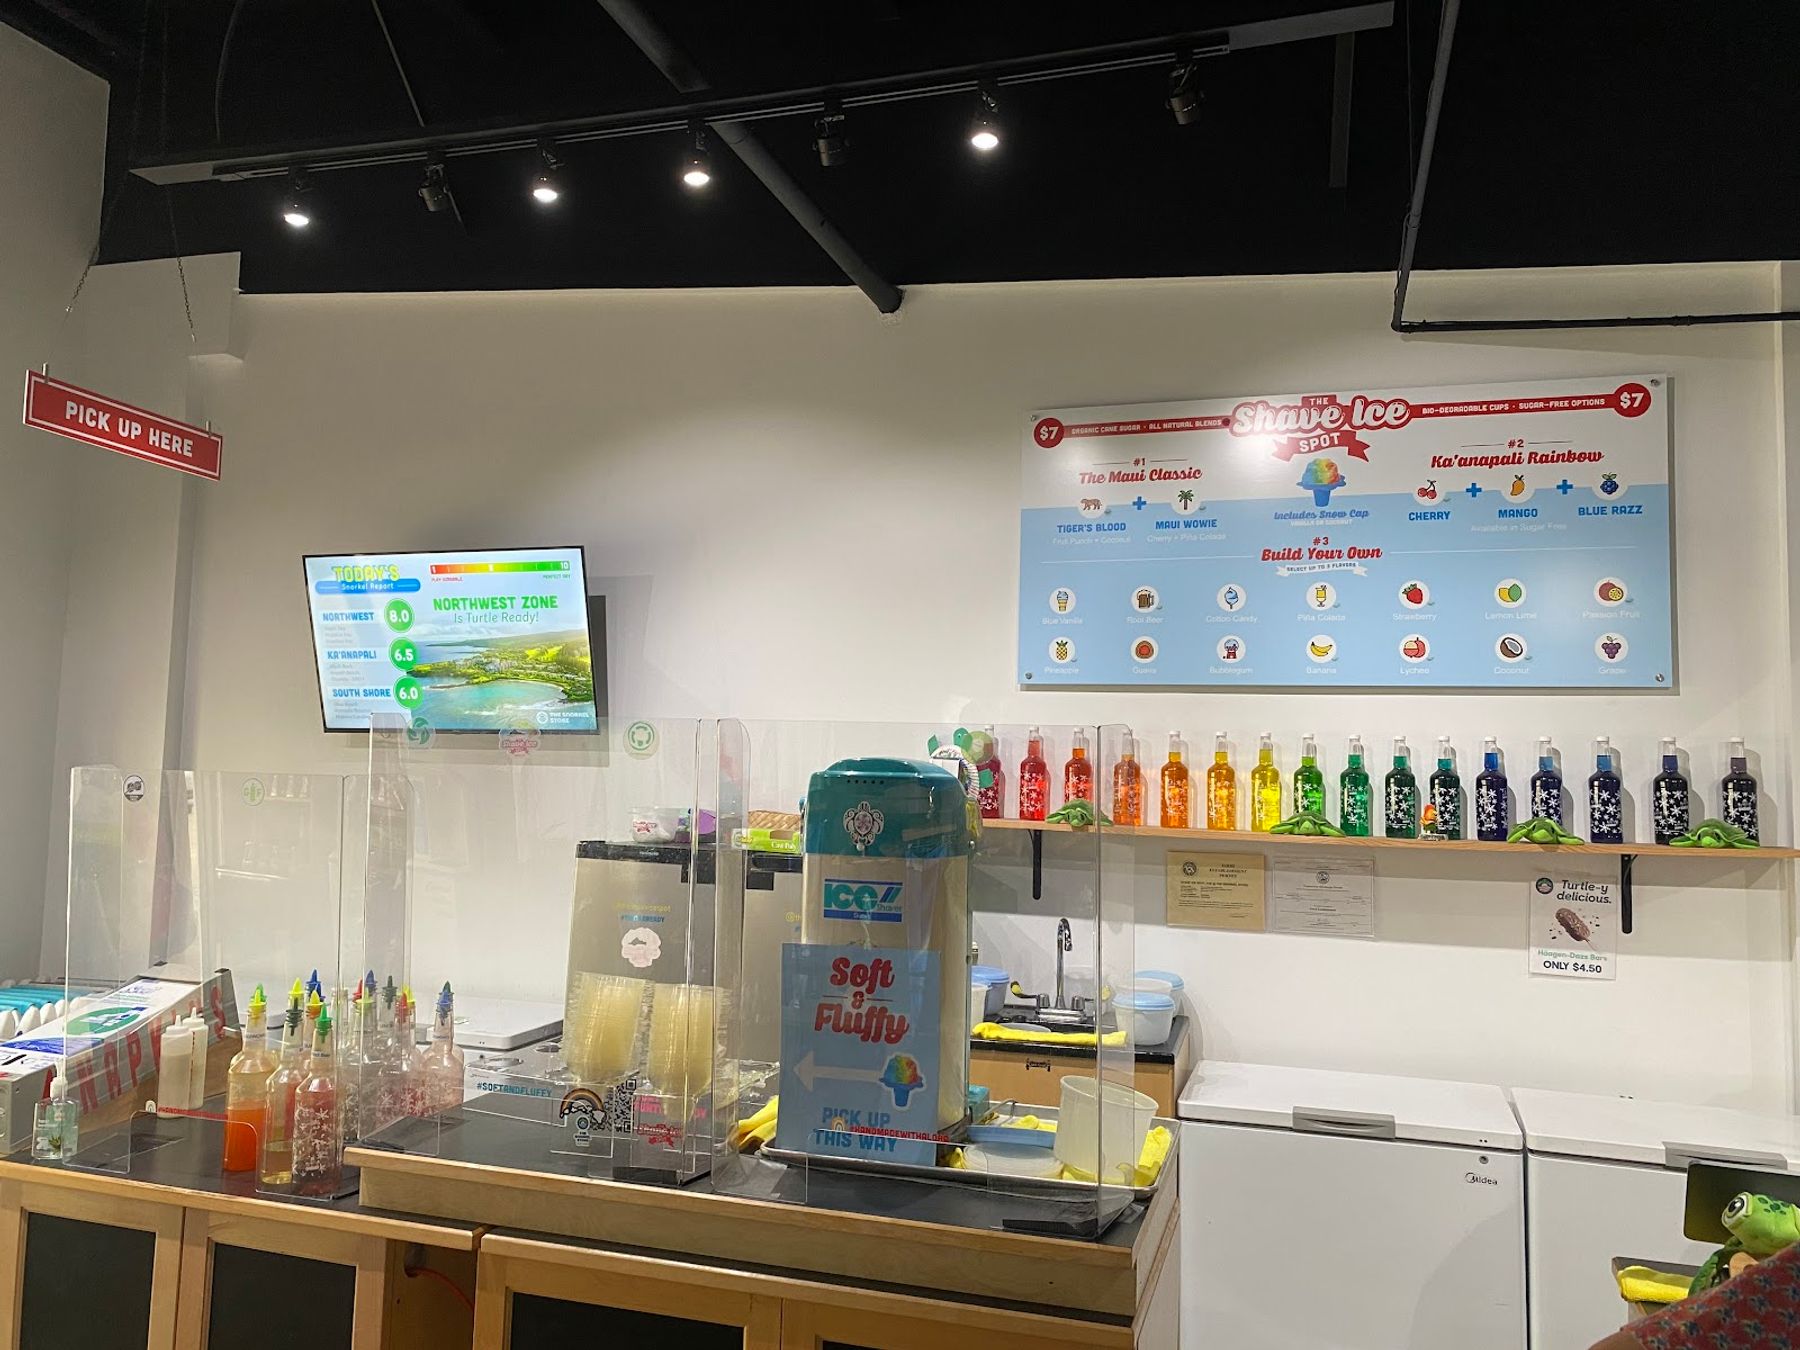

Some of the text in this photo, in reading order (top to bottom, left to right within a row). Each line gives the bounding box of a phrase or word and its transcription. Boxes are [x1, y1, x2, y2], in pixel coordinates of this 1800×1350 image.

[1309, 397, 1329, 405] THE
[1422, 398, 1606, 414] BIO-DEGRADABLE CUPS SUGAR-FREE OPTIONS
[1619, 392, 1644, 409] $7
[1232, 398, 1410, 433] Shave Ice
[65, 400, 194, 458] PICK UP HERE
[1148, 422, 1161, 430] ALL
[1039, 426, 1059, 441] $7
[1299, 432, 1341, 452] SPOT
[1507, 439, 1524, 449] #2
[1133, 457, 1147, 467] #1
[1431, 449, 1604, 469] Ka'anapali Rainbow
[1079, 466, 1203, 485] The Maui Classic
[1273, 509, 1369, 520] Includes Snow Cap
[1408, 510, 1451, 521] CHERRY
[1498, 508, 1539, 519] MANGO
[1578, 504, 1643, 516] BLUE RAZZ
[1056, 522, 1127, 534] TIGER'S BLOOD
[1155, 519, 1217, 530] MAUI WOWIE
[1312, 536, 1329, 545] #3
[1261, 546, 1383, 561] Build Your Own
[433, 595, 558, 611] NORTHWEST ZONE
[322, 612, 375, 622] NORTHWEST
[389, 610, 410, 623] 8.0
[454, 611, 539, 624] Is Turtle Ready!
[327, 650, 377, 660] KA'ANAPALI
[394, 649, 414, 662] 6.5
[332, 688, 391, 698] SOUTH SHORE
[399, 687, 419, 700] 6.0
[1561, 879, 1609, 895] Turtle-y
[1556, 891, 1612, 904] delicious.
[1543, 960, 1603, 974] ONLY $4.50
[830, 957, 895, 995] Soft
[851, 991, 865, 1009] &
[814, 1002, 910, 1045] Fluffy
[476, 1081, 552, 1098] #SOFTANDFLUFFY
[822, 1106, 891, 1128] PICK UP
[813, 1129, 898, 1152] THIS WAY
